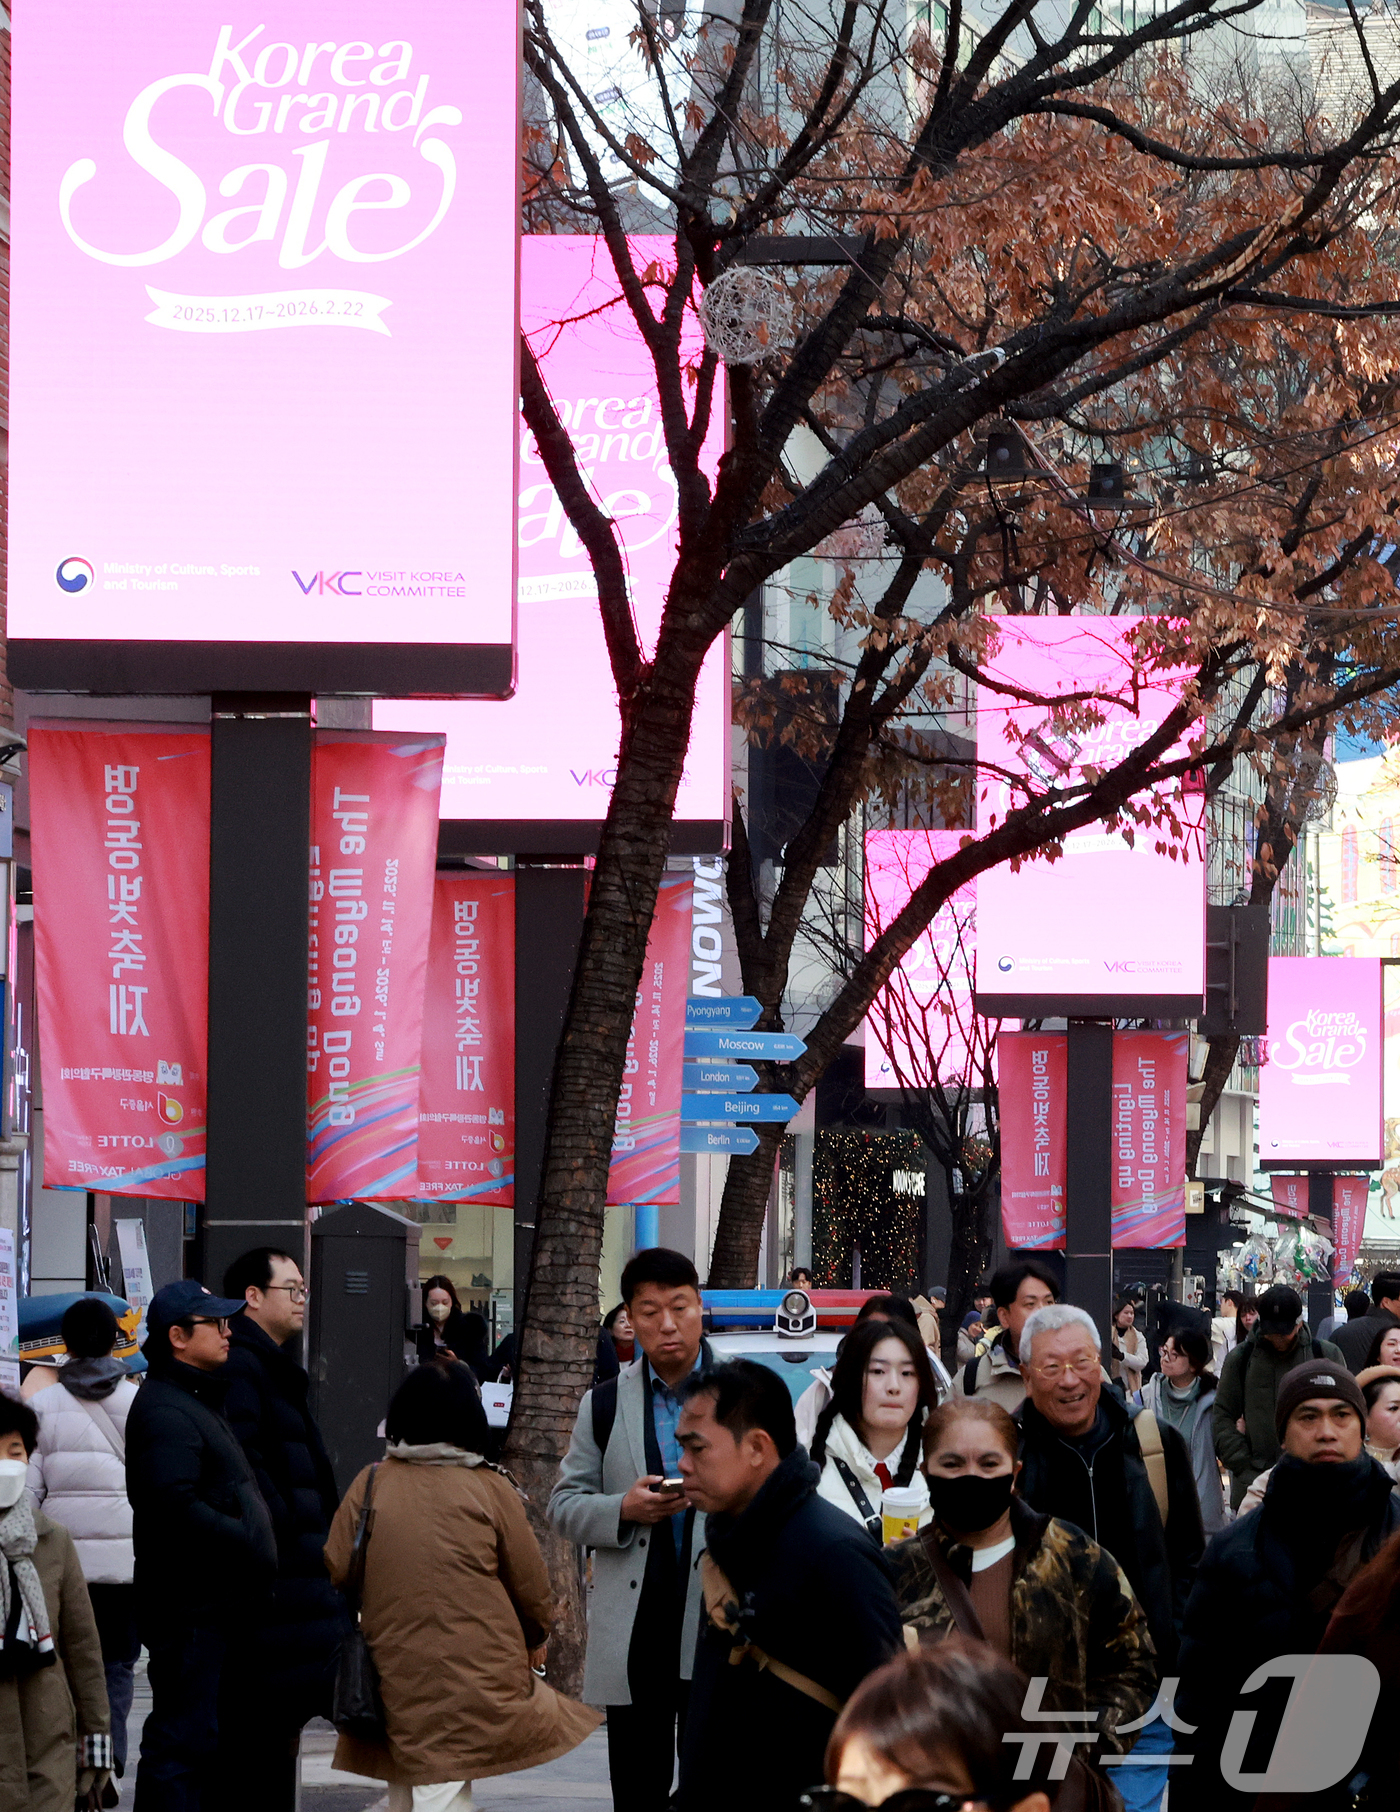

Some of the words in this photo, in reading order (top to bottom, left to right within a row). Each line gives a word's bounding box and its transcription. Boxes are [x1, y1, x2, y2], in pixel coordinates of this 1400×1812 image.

[208, 23, 413, 88] Korea
[223, 74, 430, 136] Grand
[58, 73, 463, 270] Sale
[172, 300, 365, 323] 2025.12.17~2026.2.22
[104, 562, 151, 576] Ministry
[154, 563, 168, 575] of
[170, 563, 218, 577] Culture,
[220, 564, 261, 578] Sports
[366, 571, 407, 581] VISIT
[410, 572, 466, 582] KOREA
[103, 579, 127, 591] and
[130, 578, 179, 591] Tourism
[291, 570, 363, 596] VKC
[366, 585, 466, 597] COMMITTEE
[474, 765, 484, 773] of
[485, 765, 519, 774] Culture,
[458, 776, 491, 785] Tourism
[1103, 960, 1136, 973] VKC
[687, 1004, 731, 1018] Pyongyang
[1305, 1008, 1356, 1026] Korea
[1309, 1019, 1360, 1038] Grand
[718, 1037, 765, 1051] Moscow
[1270, 1020, 1368, 1070] Sale
[700, 1071, 730, 1083] London
[724, 1101, 760, 1115] Beijing
[707, 1133, 731, 1145] Berlin
